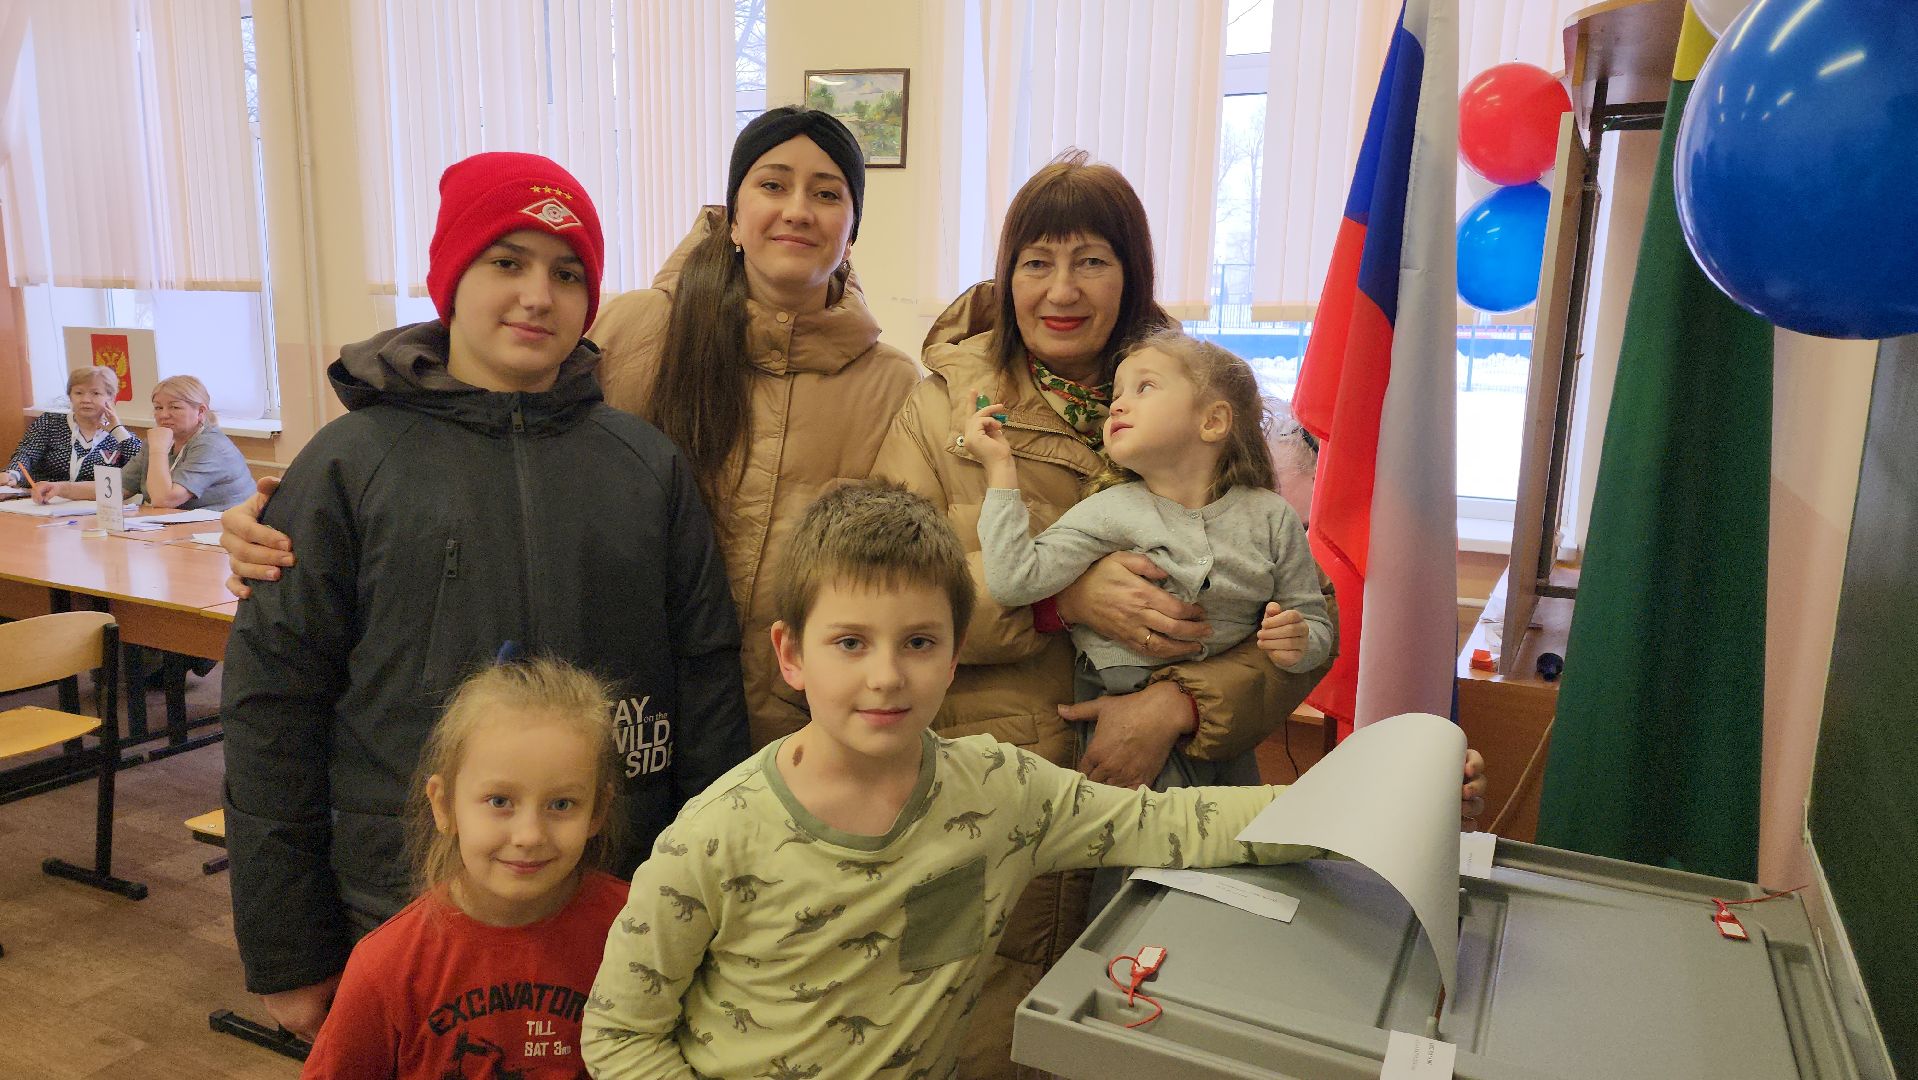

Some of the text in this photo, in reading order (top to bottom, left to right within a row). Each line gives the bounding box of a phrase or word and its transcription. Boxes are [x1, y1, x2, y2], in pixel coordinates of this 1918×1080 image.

[104, 476, 113, 499] 3
[613, 696, 668, 727] AY on the
[428, 980, 589, 1037] EXCAVATOR
[526, 1020, 556, 1036] TILL
[524, 1041, 549, 1057] SAT
